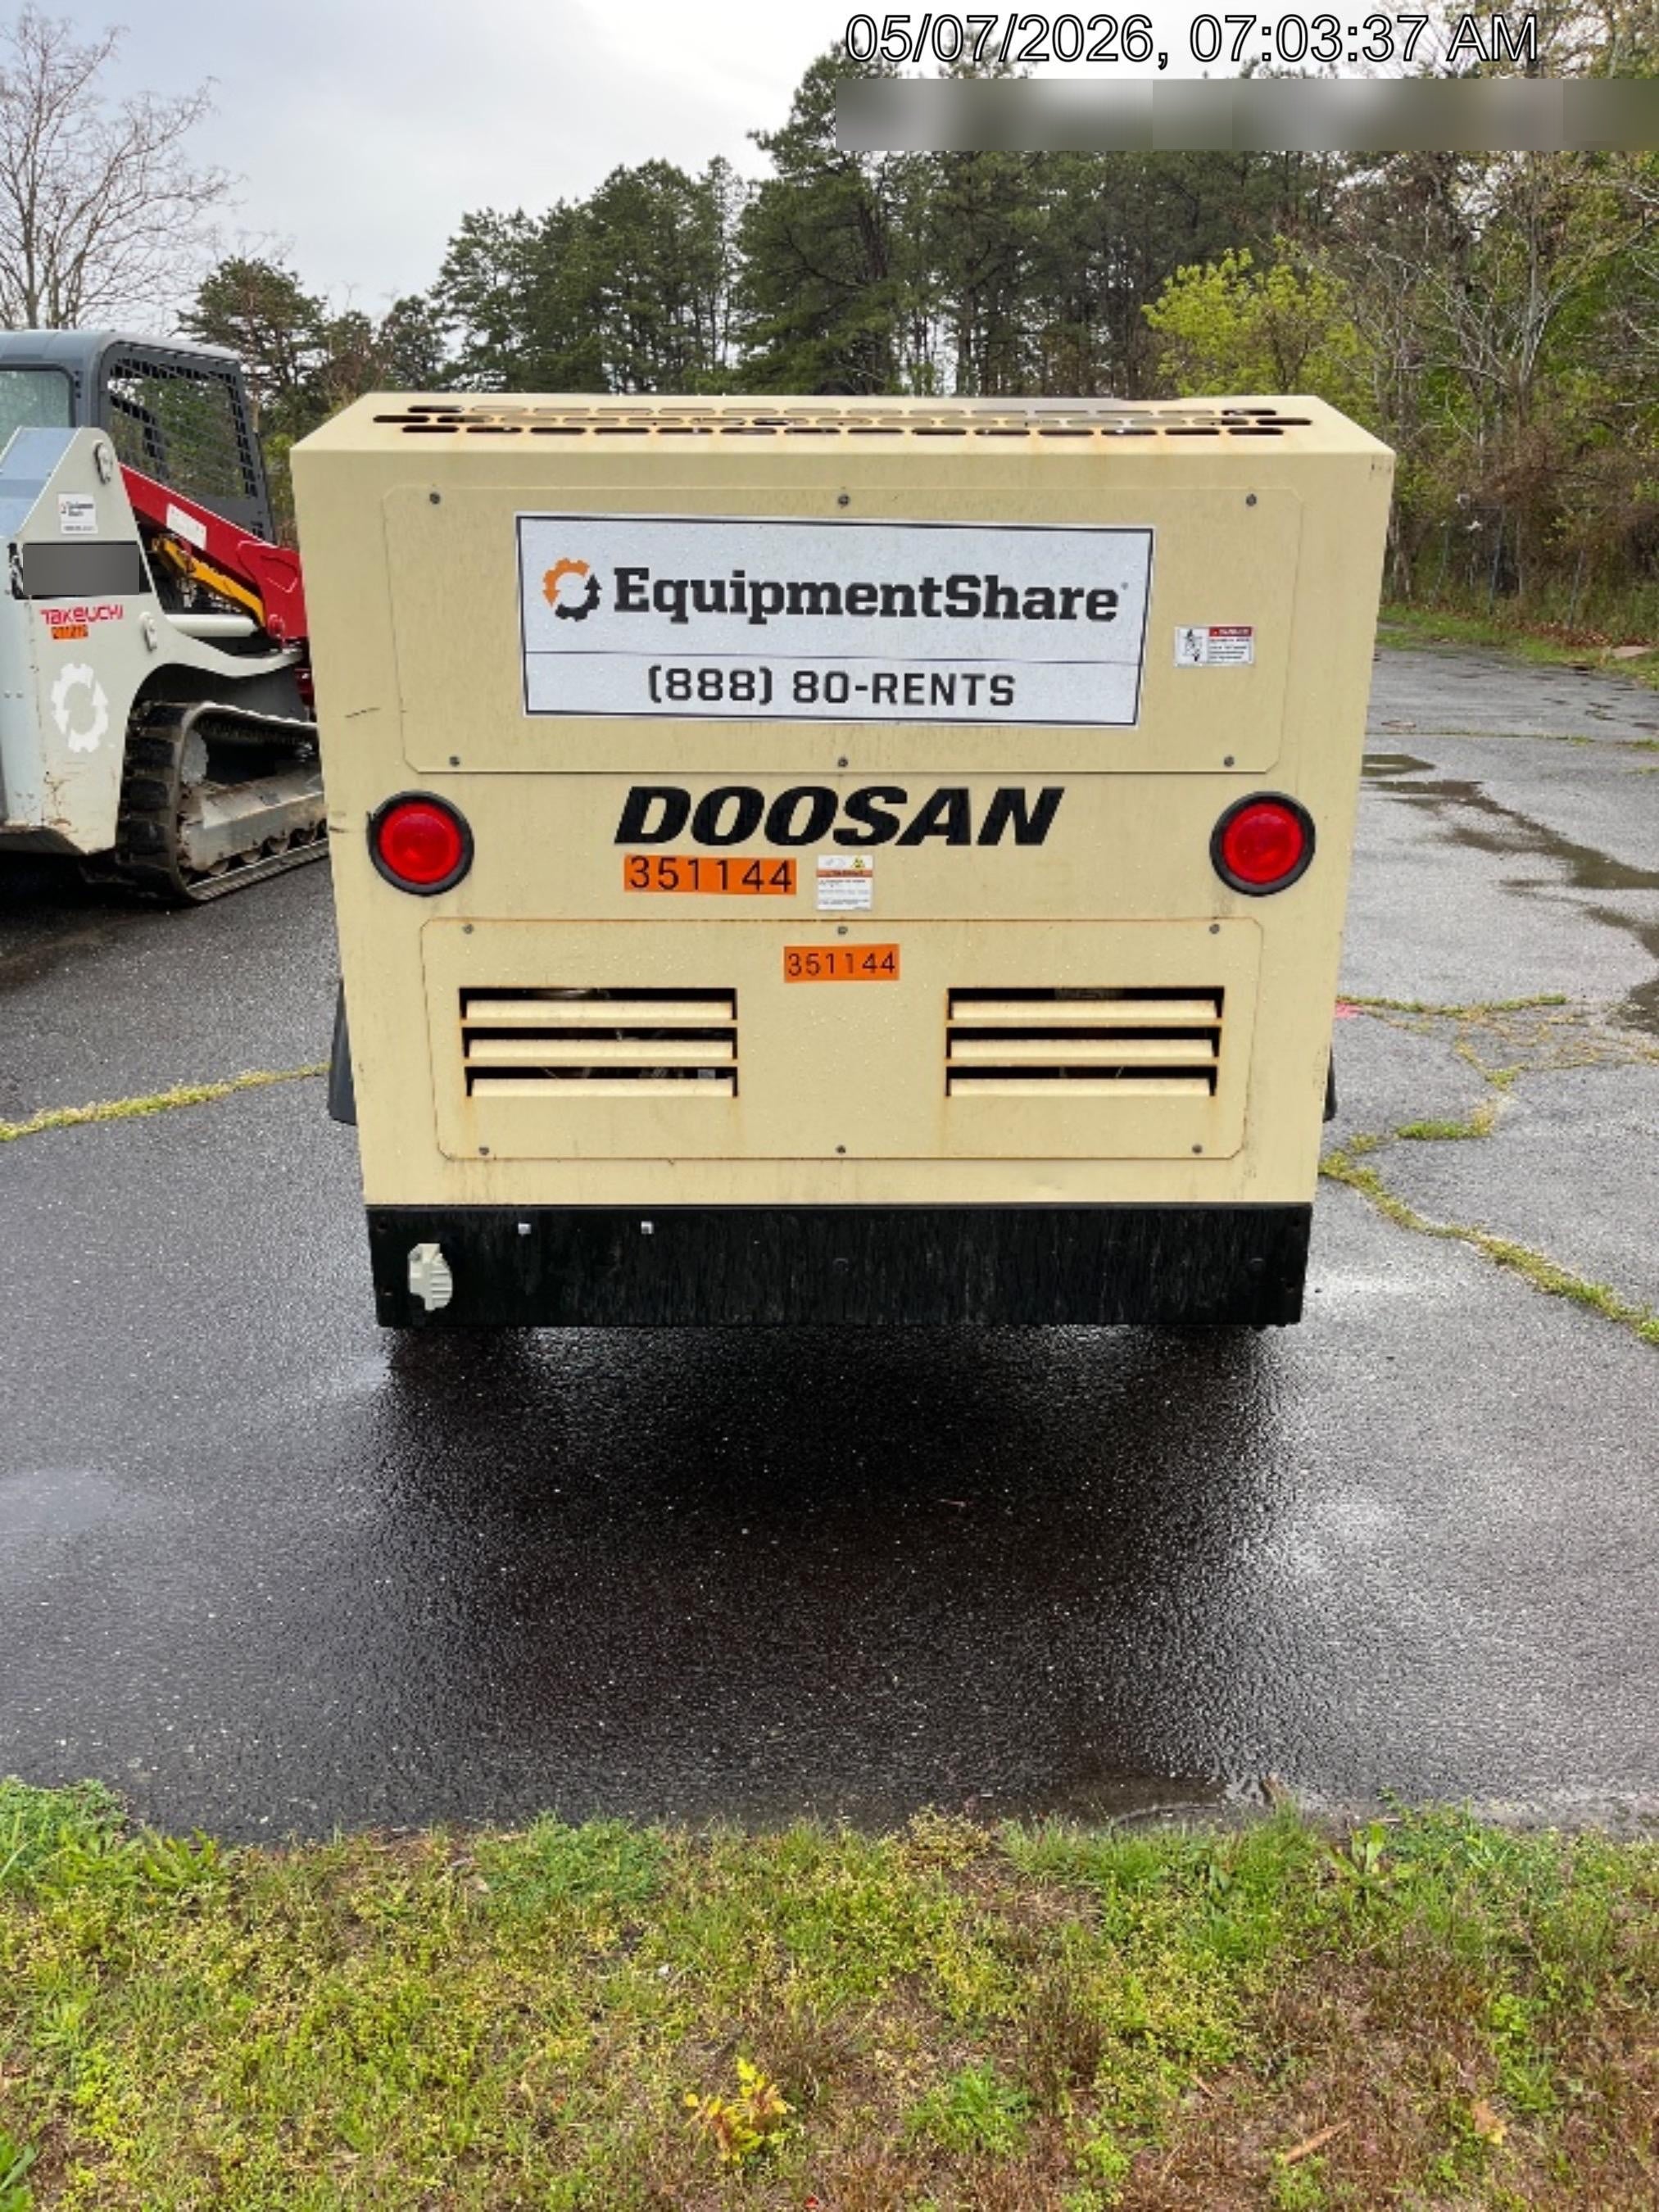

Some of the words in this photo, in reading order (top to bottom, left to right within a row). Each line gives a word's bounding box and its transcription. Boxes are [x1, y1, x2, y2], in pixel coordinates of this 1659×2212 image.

[614, 567, 1119, 625] EquipmentShare
[648, 665, 773, 705] (888)
[792, 670, 1015, 706] 80-RENTS
[614, 786, 1065, 845] DOOSAN
[630, 856, 792, 893] 351144
[787, 952, 896, 977] 351144
